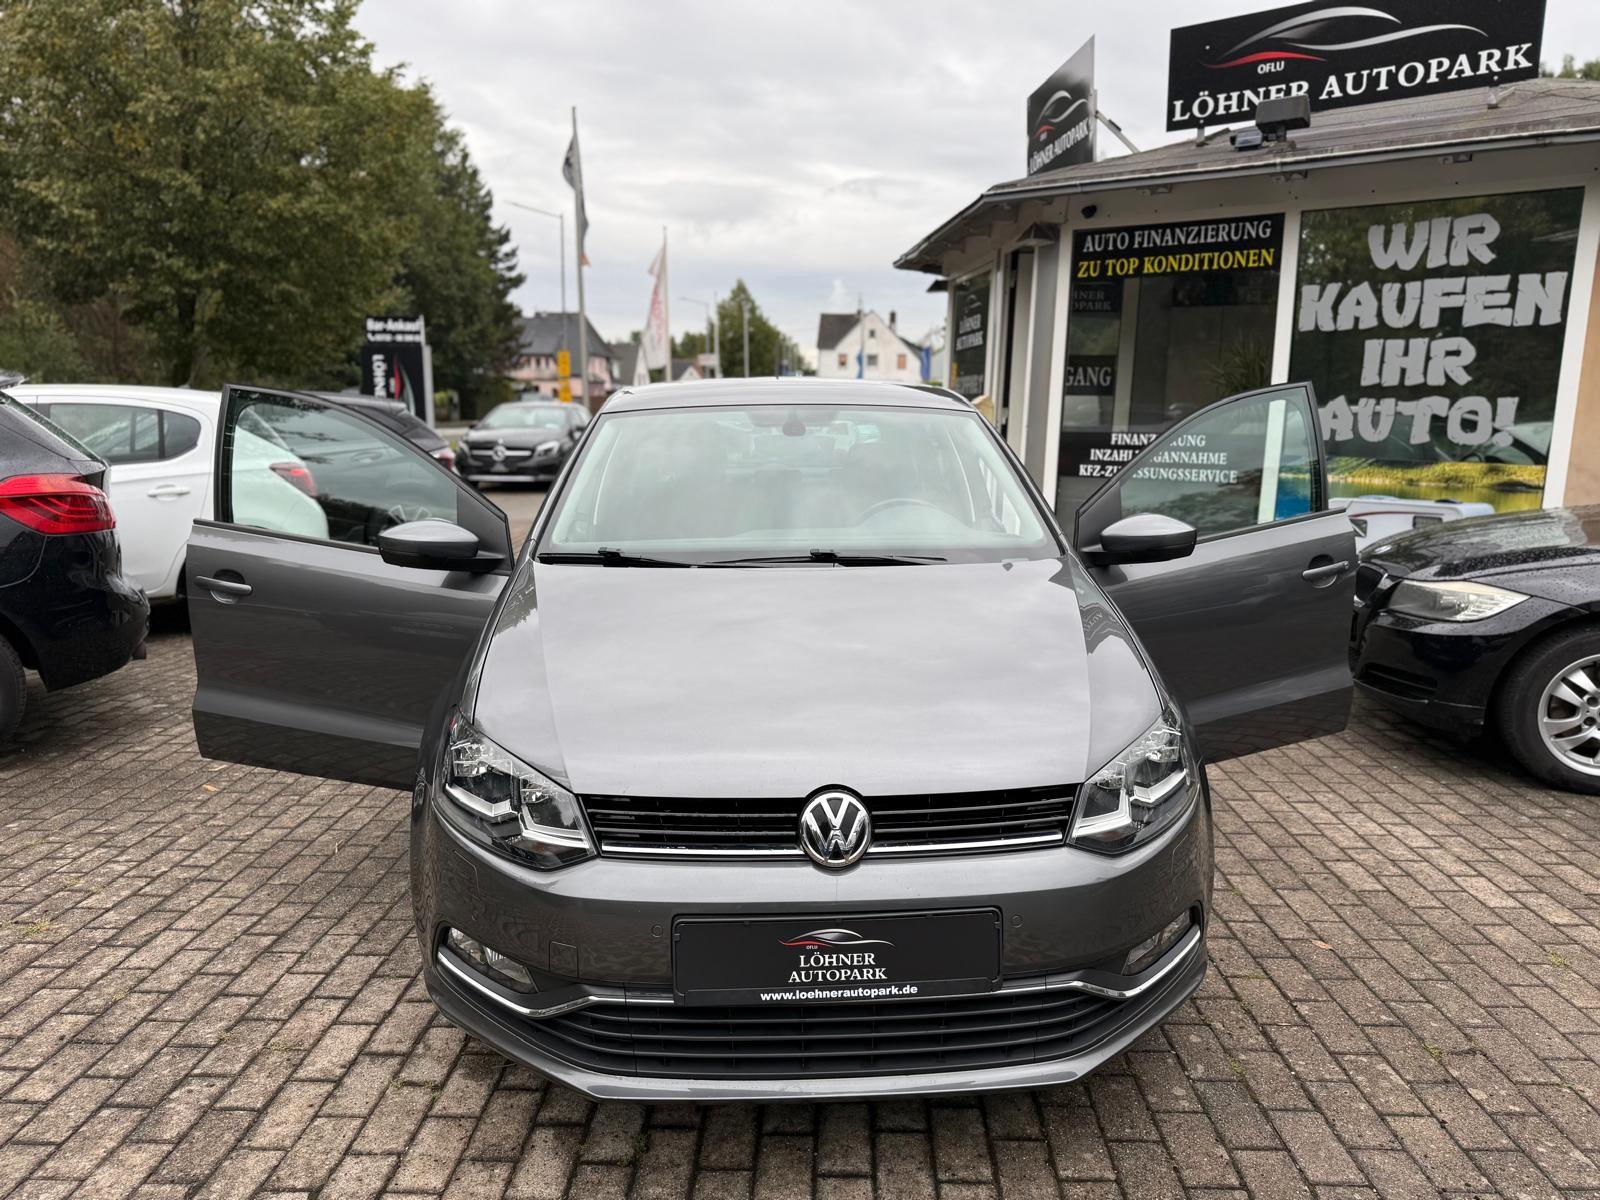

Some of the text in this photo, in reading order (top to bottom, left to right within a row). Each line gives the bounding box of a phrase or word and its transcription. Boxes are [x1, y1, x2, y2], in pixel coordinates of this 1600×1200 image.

[1172, 43, 1533, 122] LÖHNER AUTOPARK
[1257, 61, 1285, 74] OFLU
[1054, 118, 1089, 156] AUTOPARK
[1083, 220, 1272, 252] AUTO FINANZIERUNG
[1368, 213, 1501, 271] WIR
[1077, 248, 1275, 278] ZU TOP KONDITIONEN
[1298, 272, 1569, 332] KAUFEN
[1360, 337, 1477, 387] IHR
[1318, 394, 1519, 447] AUTO!
[1090, 448, 1227, 464] INZAHLGANNAHME
[1111, 433, 1206, 447] FINANZUNG
[801, 792, 870, 866] VW
[788, 968, 888, 983] AUTOPARK
[800, 952, 876, 968] LÖHNER
[760, 985, 918, 1001] www.loehnerautopark.de
